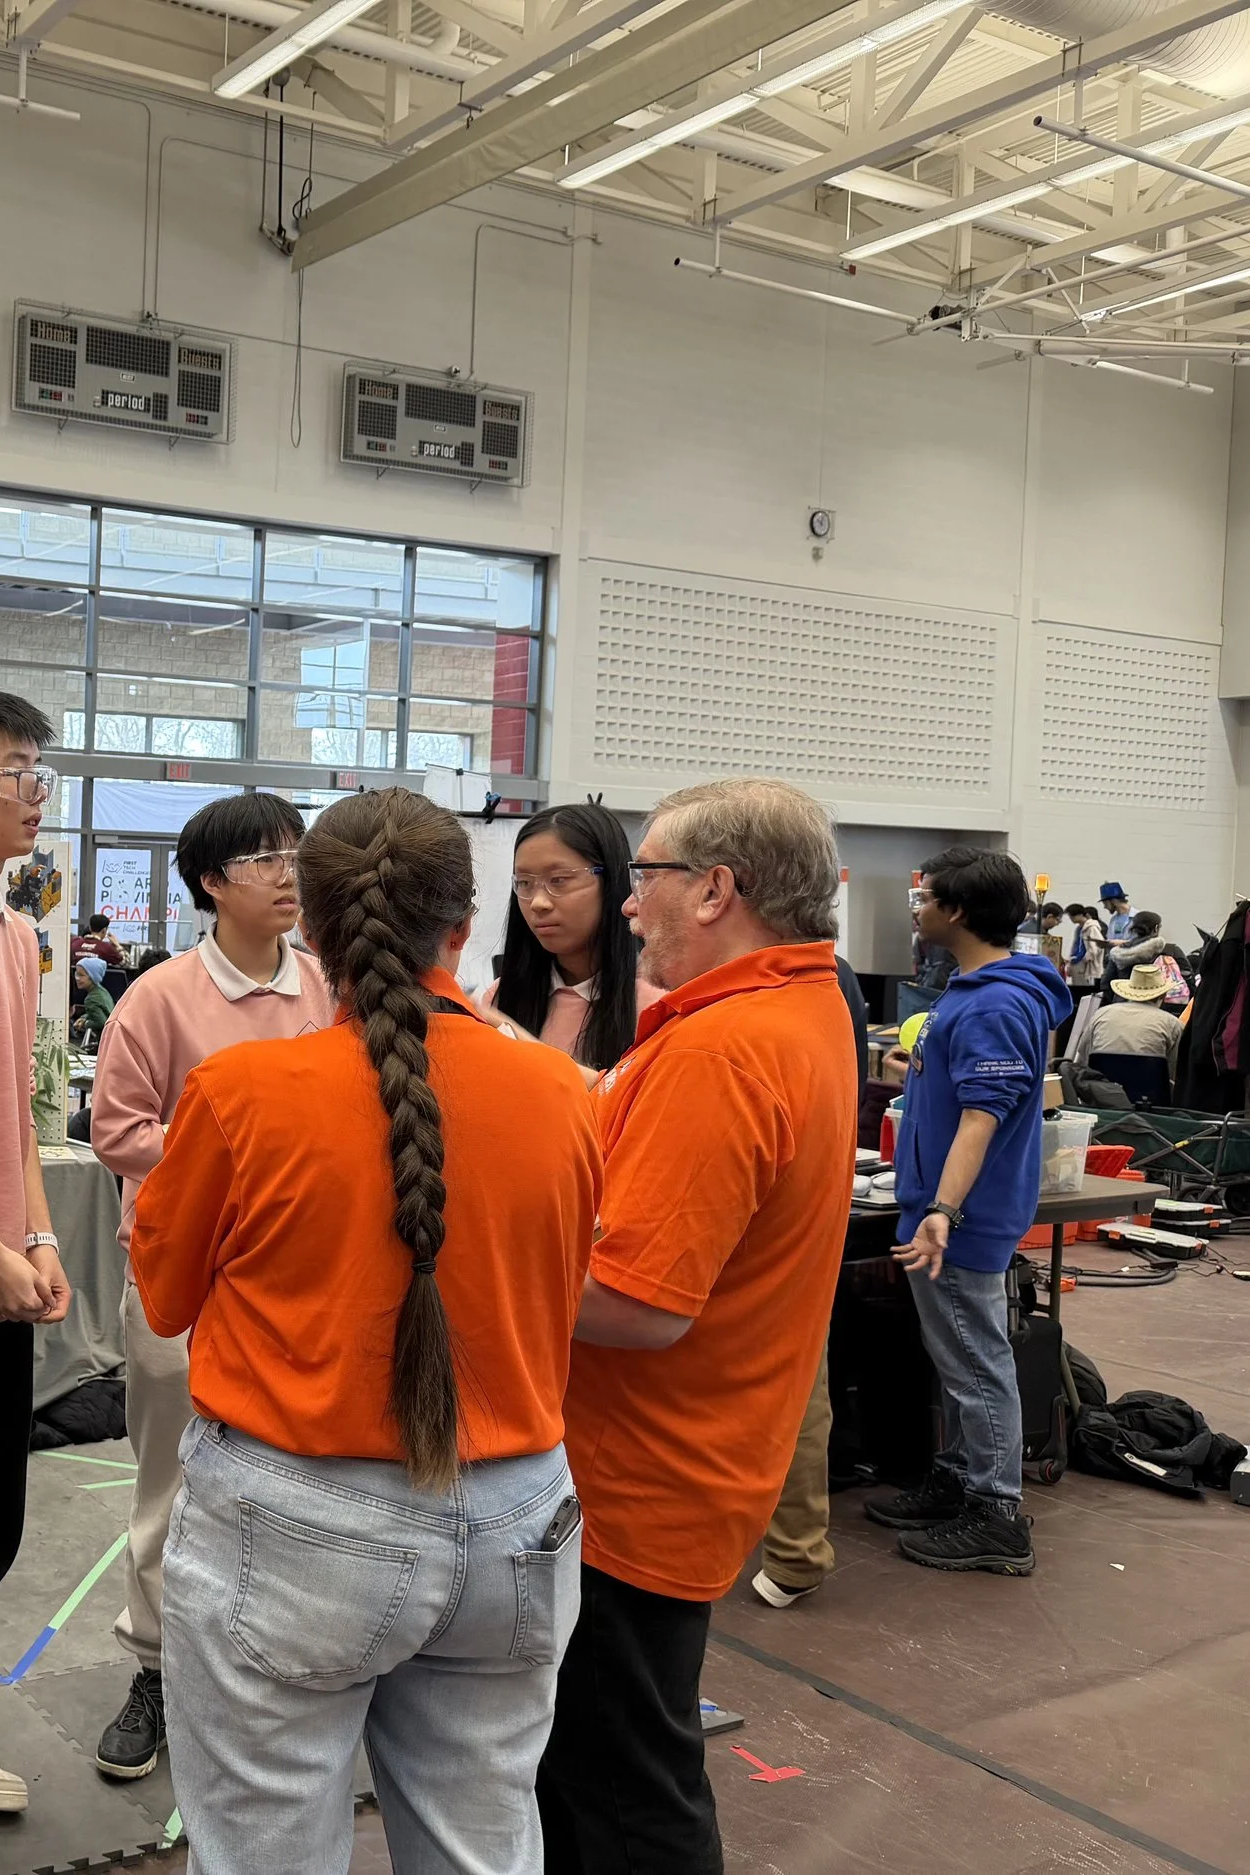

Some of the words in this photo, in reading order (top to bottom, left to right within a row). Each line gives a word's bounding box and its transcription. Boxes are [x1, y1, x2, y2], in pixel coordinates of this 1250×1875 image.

[37, 320, 71, 342] Home
[365, 382, 393, 398] Home
[108, 392, 146, 411] period
[423, 443, 455, 459] period
[169, 764, 190, 779] EXIT
[339, 771, 358, 786] EXIT
